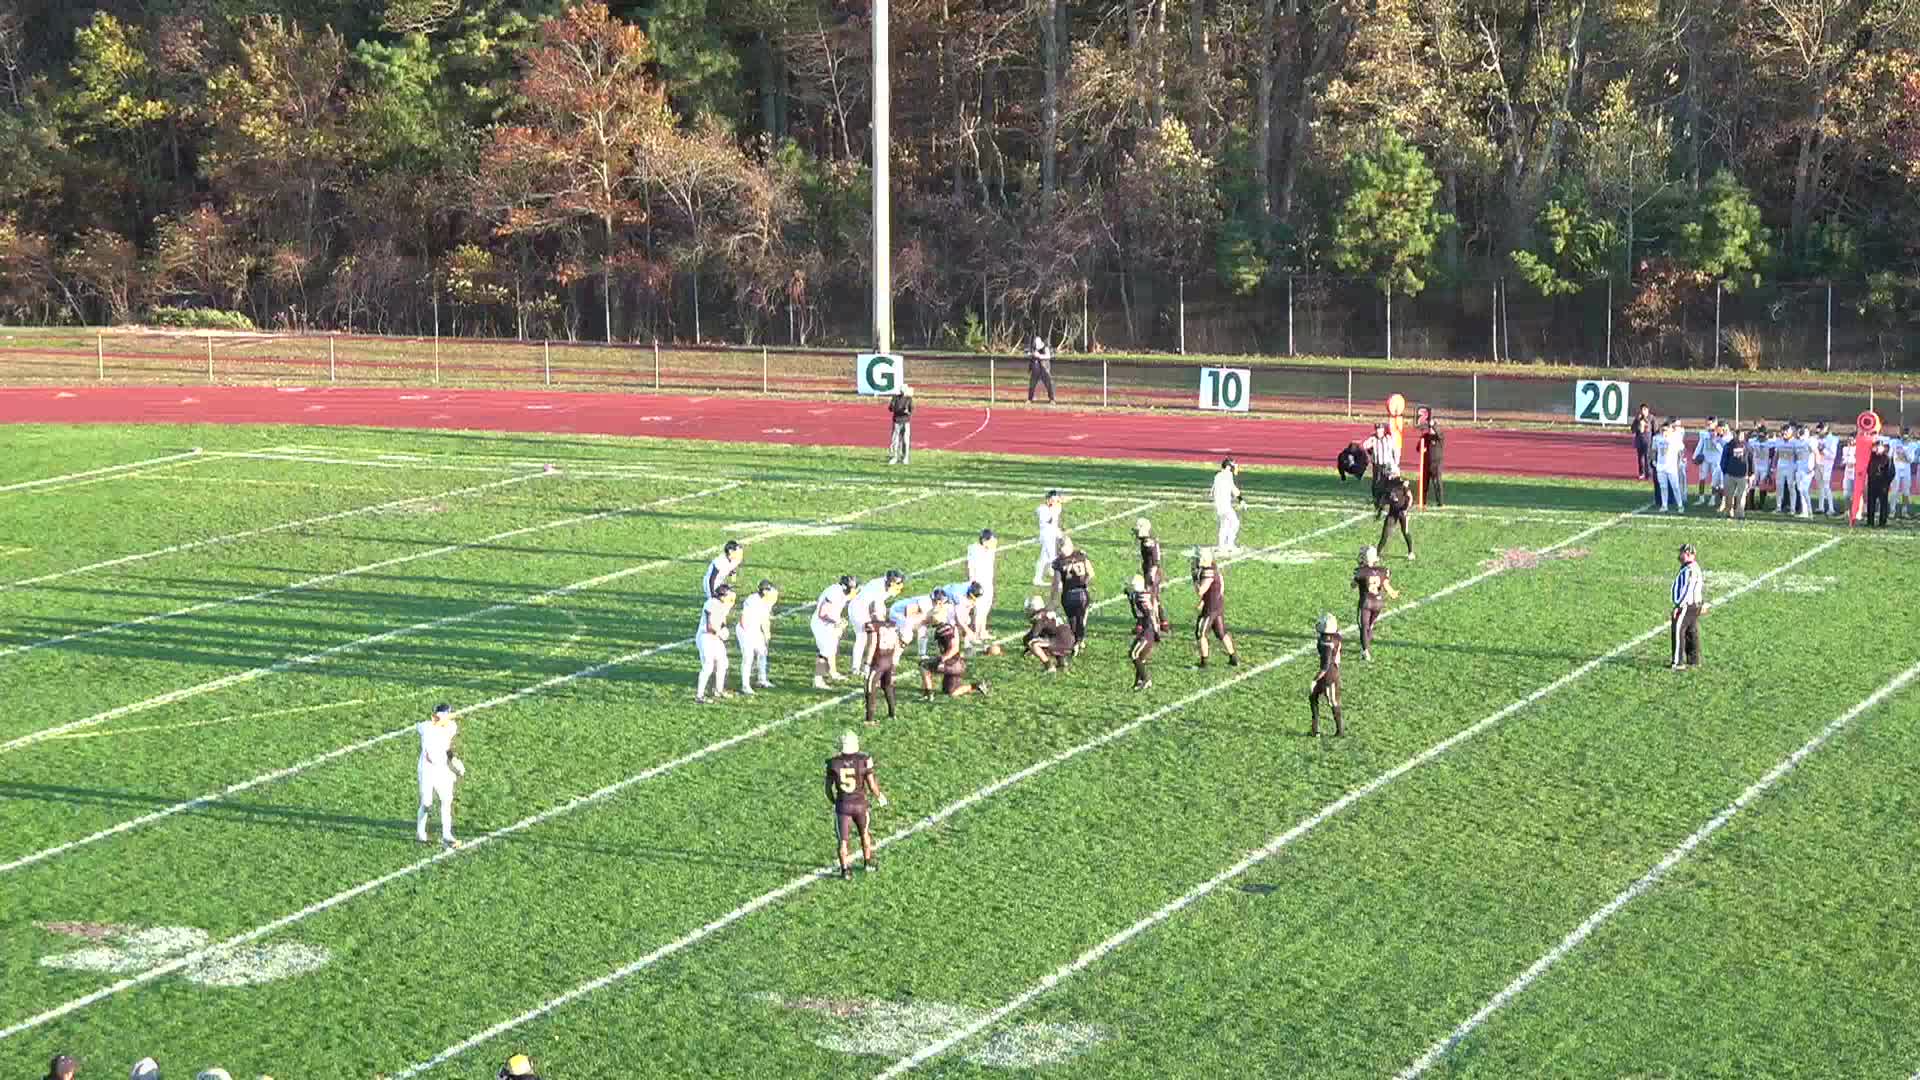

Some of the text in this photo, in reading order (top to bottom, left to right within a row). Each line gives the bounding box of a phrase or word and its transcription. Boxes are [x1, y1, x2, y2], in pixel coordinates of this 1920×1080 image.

[866, 356, 895, 392] G
[1208, 370, 1242, 408] 10
[1580, 382, 1623, 421] 20
[840, 767, 857, 793] 5
